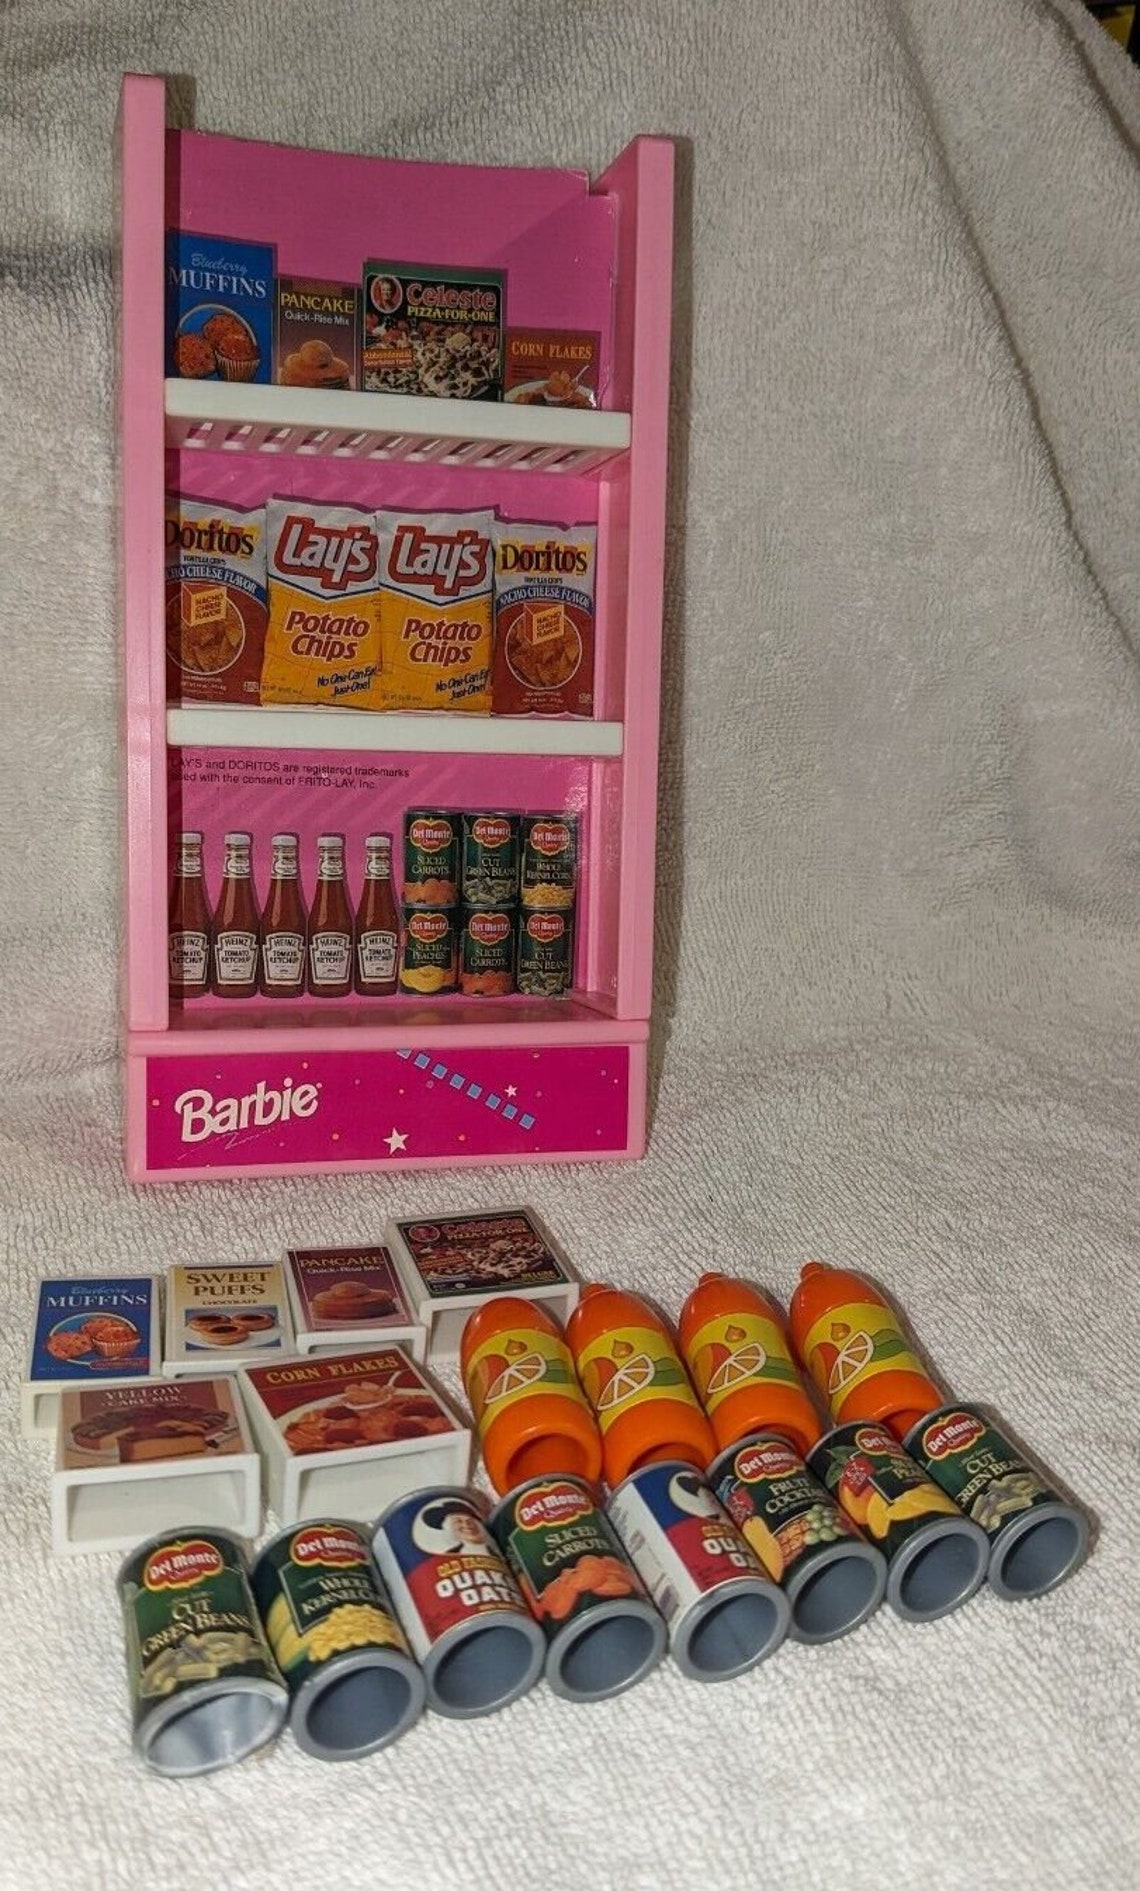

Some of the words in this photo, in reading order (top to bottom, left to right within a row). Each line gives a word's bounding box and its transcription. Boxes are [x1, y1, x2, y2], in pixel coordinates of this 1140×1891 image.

[191, 253, 248, 275] Blueberry
[169, 267, 267, 299] MUFFINS
[280, 292, 355, 314] PANCAKE
[406, 283, 497, 312] Celeste
[284, 310, 333, 326] Quick-Rise
[334, 315, 350, 326] Mix
[512, 341, 544, 356] CORN
[549, 344, 592, 360] FLAKES
[165, 519, 254, 556] Doritos
[280, 522, 373, 583] Lay's
[395, 531, 483, 589] Lay's
[500, 541, 587, 573] Doritos
[187, 566, 222, 579] CHEESE
[224, 572, 257, 593] FLAVOR
[528, 586, 560, 598] CHEESE
[285, 611, 370, 638] Potato
[403, 617, 483, 642] Potato
[291, 634, 358, 662] Chips
[409, 641, 473, 667] Chips
[317, 676, 330, 687] No
[436, 680, 448, 693] No
[206, 760, 225, 770] and
[228, 760, 280, 772] DORITOS
[283, 763, 299, 773] are
[303, 764, 353, 776] registered
[355, 767, 410, 778] trademarks
[200, 773, 220, 783] with
[223, 773, 240, 784] the
[242, 776, 282, 785] consent
[284, 776, 295, 786] of
[413, 829, 425, 839] Del
[412, 864, 449, 875] CARROTS
[482, 856, 500, 867] CUT
[225, 938, 248, 947] HEINZ
[273, 938, 297, 947] HEINZ
[175, 1077, 319, 1142] Barbie
[300, 1256, 384, 1268] PANCAKE
[186, 1271, 270, 1285] SWEET
[193, 1283, 265, 1297] PUFFS
[46, 1294, 148, 1308] MUFFINS
[266, 1365, 320, 1385] CORN
[329, 1355, 399, 1376] FLAKES
[105, 1386, 181, 1399] YELLOW
[861, 1436, 884, 1449] Del
[927, 1433, 945, 1453] Del
[943, 1419, 980, 1439] Monte
[739, 1456, 763, 1475] Del
[966, 1452, 997, 1474] CUT
[768, 1477, 809, 1496] FRUIT
[520, 1500, 545, 1521] Del
[545, 1526, 598, 1548] SLICED
[296, 1538, 323, 1557] Del
[149, 1559, 172, 1580] Del
[171, 1551, 219, 1570] Monte
[437, 1559, 462, 1577] OLD
[172, 1598, 212, 1620] CUT
[142, 1620, 194, 1657] GREEN
